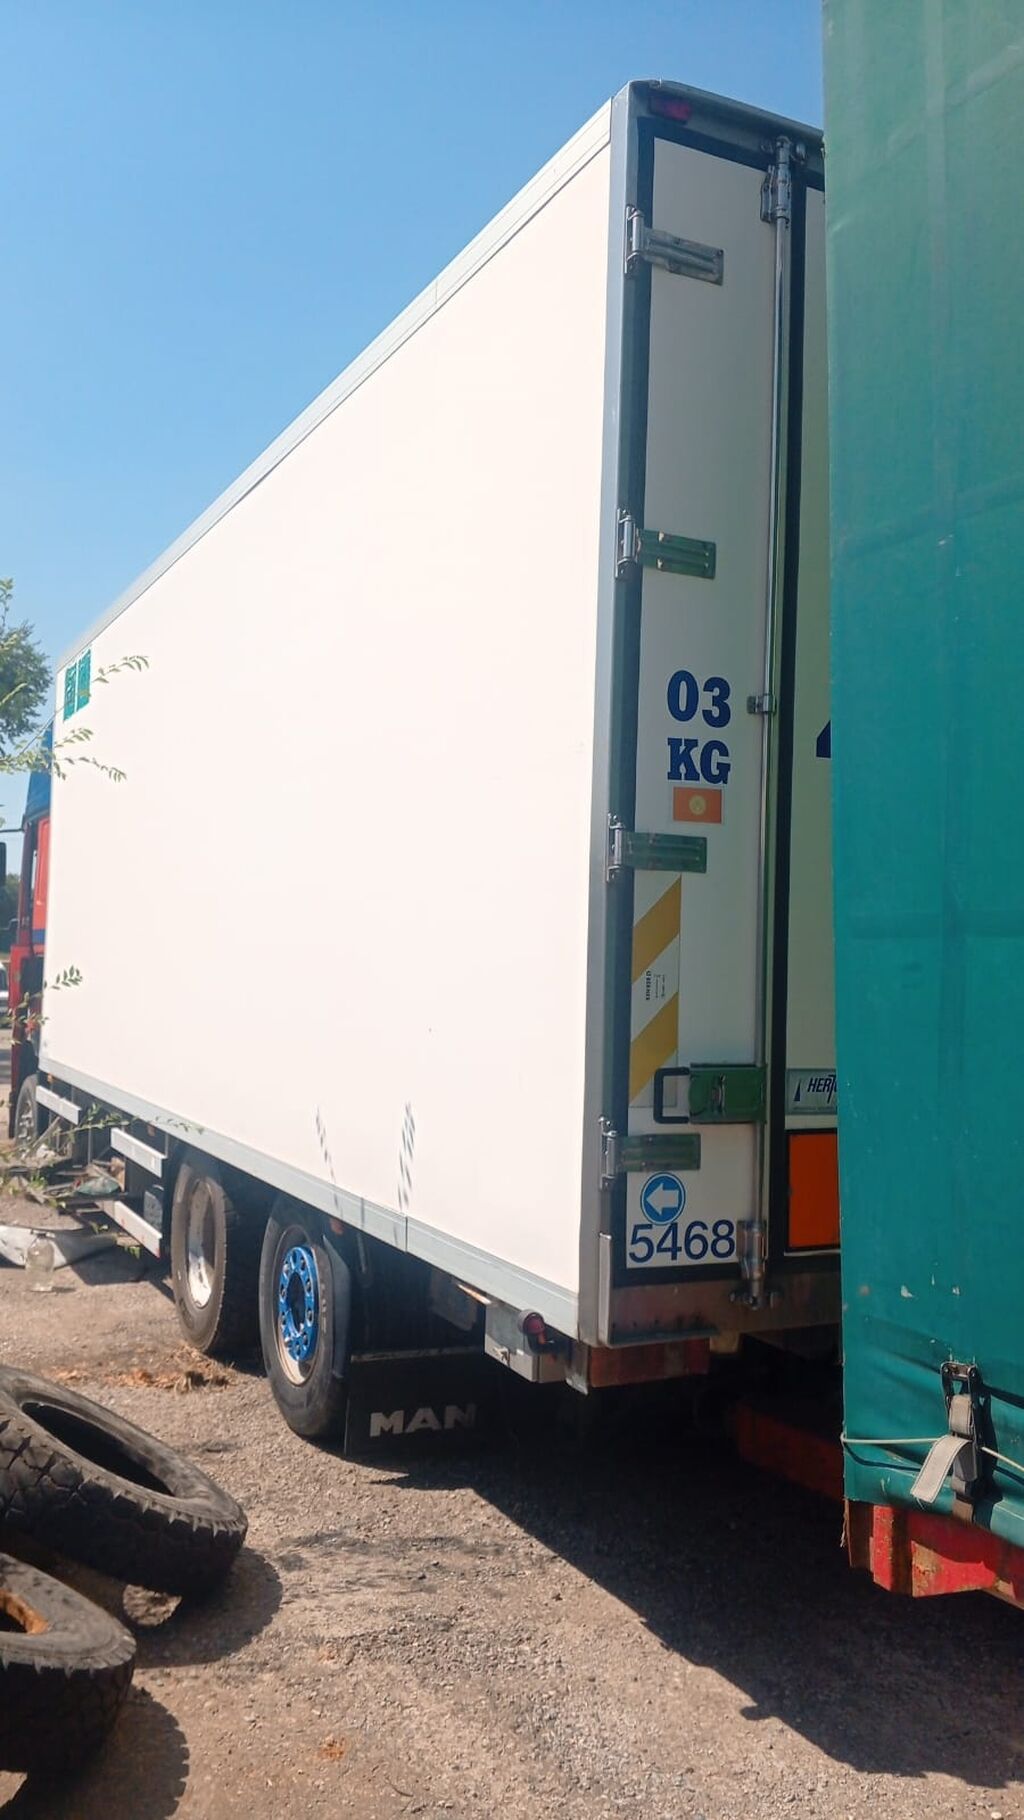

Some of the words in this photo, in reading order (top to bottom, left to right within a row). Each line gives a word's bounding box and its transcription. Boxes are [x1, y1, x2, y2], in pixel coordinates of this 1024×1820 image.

[667, 670, 731, 728] 03
[667, 737, 731, 784] KG
[629, 1219, 736, 1263] 5468
[369, 1403, 477, 1437] MAN
